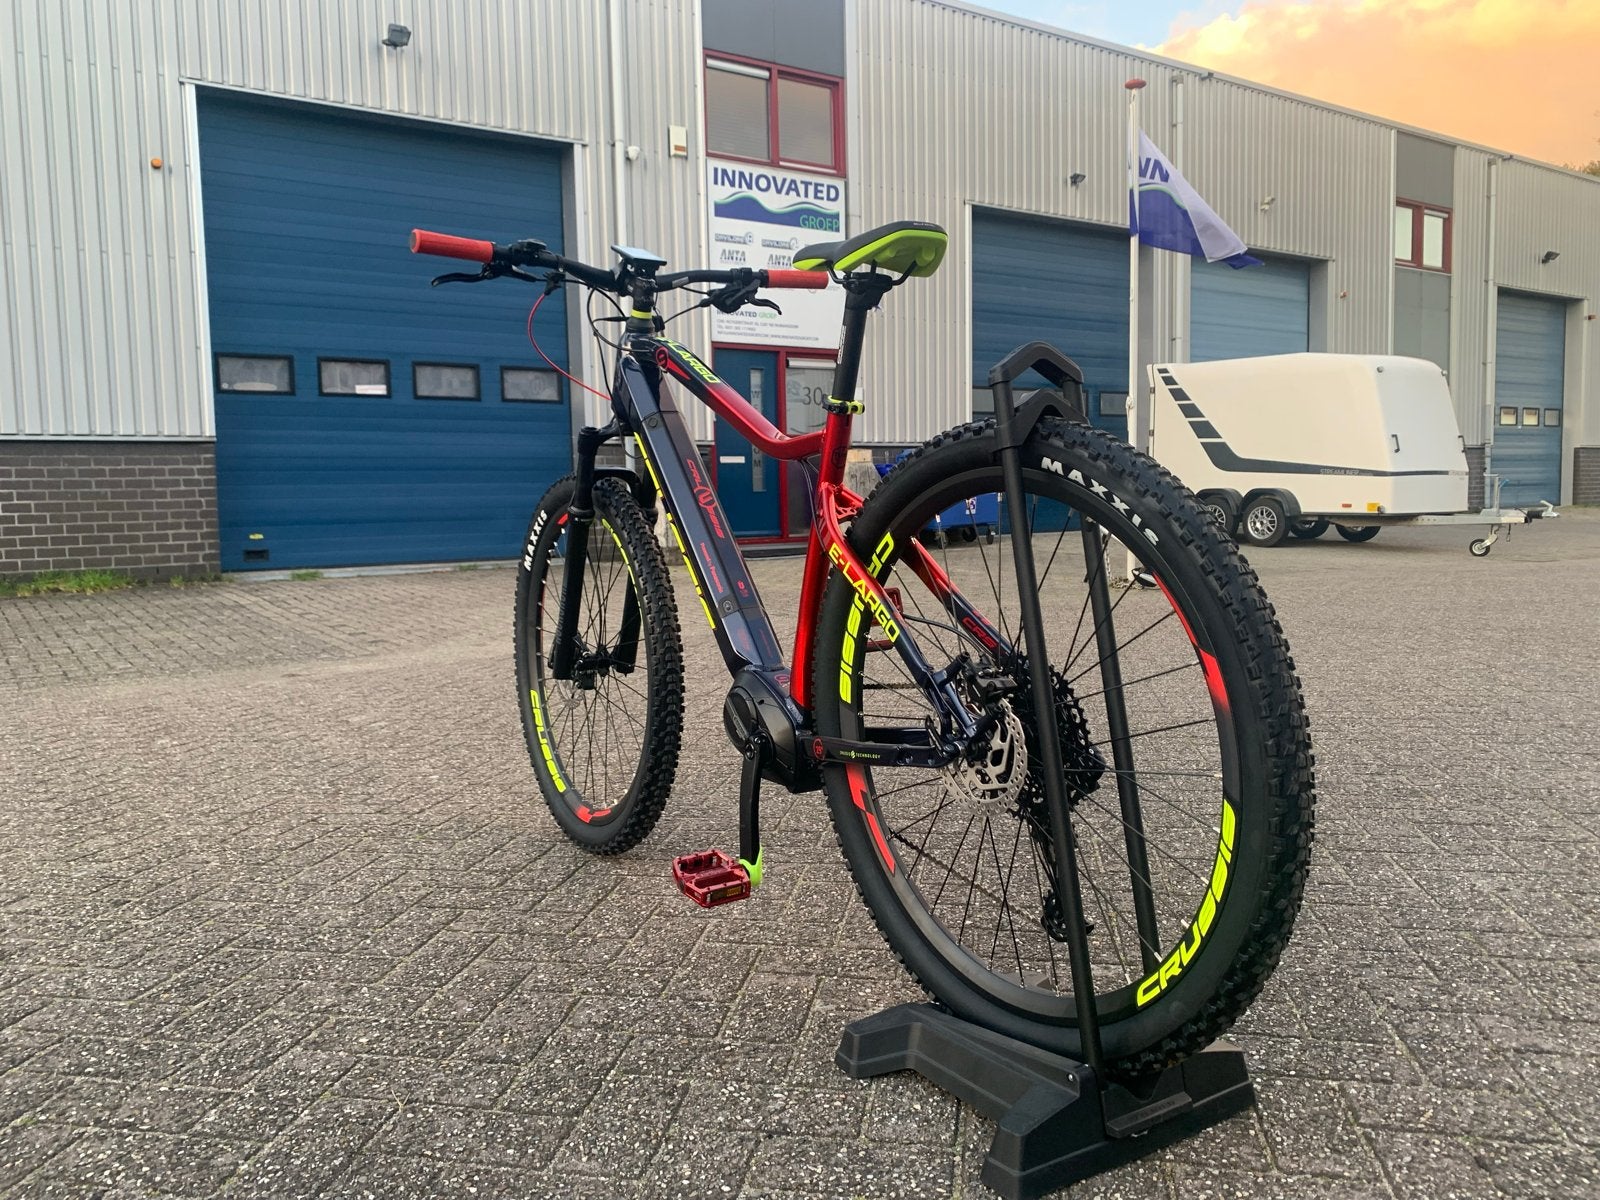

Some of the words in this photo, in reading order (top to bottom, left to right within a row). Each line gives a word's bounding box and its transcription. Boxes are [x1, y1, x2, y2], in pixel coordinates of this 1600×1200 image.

[713, 166, 840, 202] INNOVATED
[800, 214, 839, 232] GROEP
[720, 249, 746, 263] ANTA
[802, 386, 823, 406] 30
[1041, 456, 1160, 546] MAXXIS
[524, 509, 548, 572] MAXXIS
[828, 542, 901, 643] E-LARGO
[1136, 798, 1236, 1007] CRUSSIS
